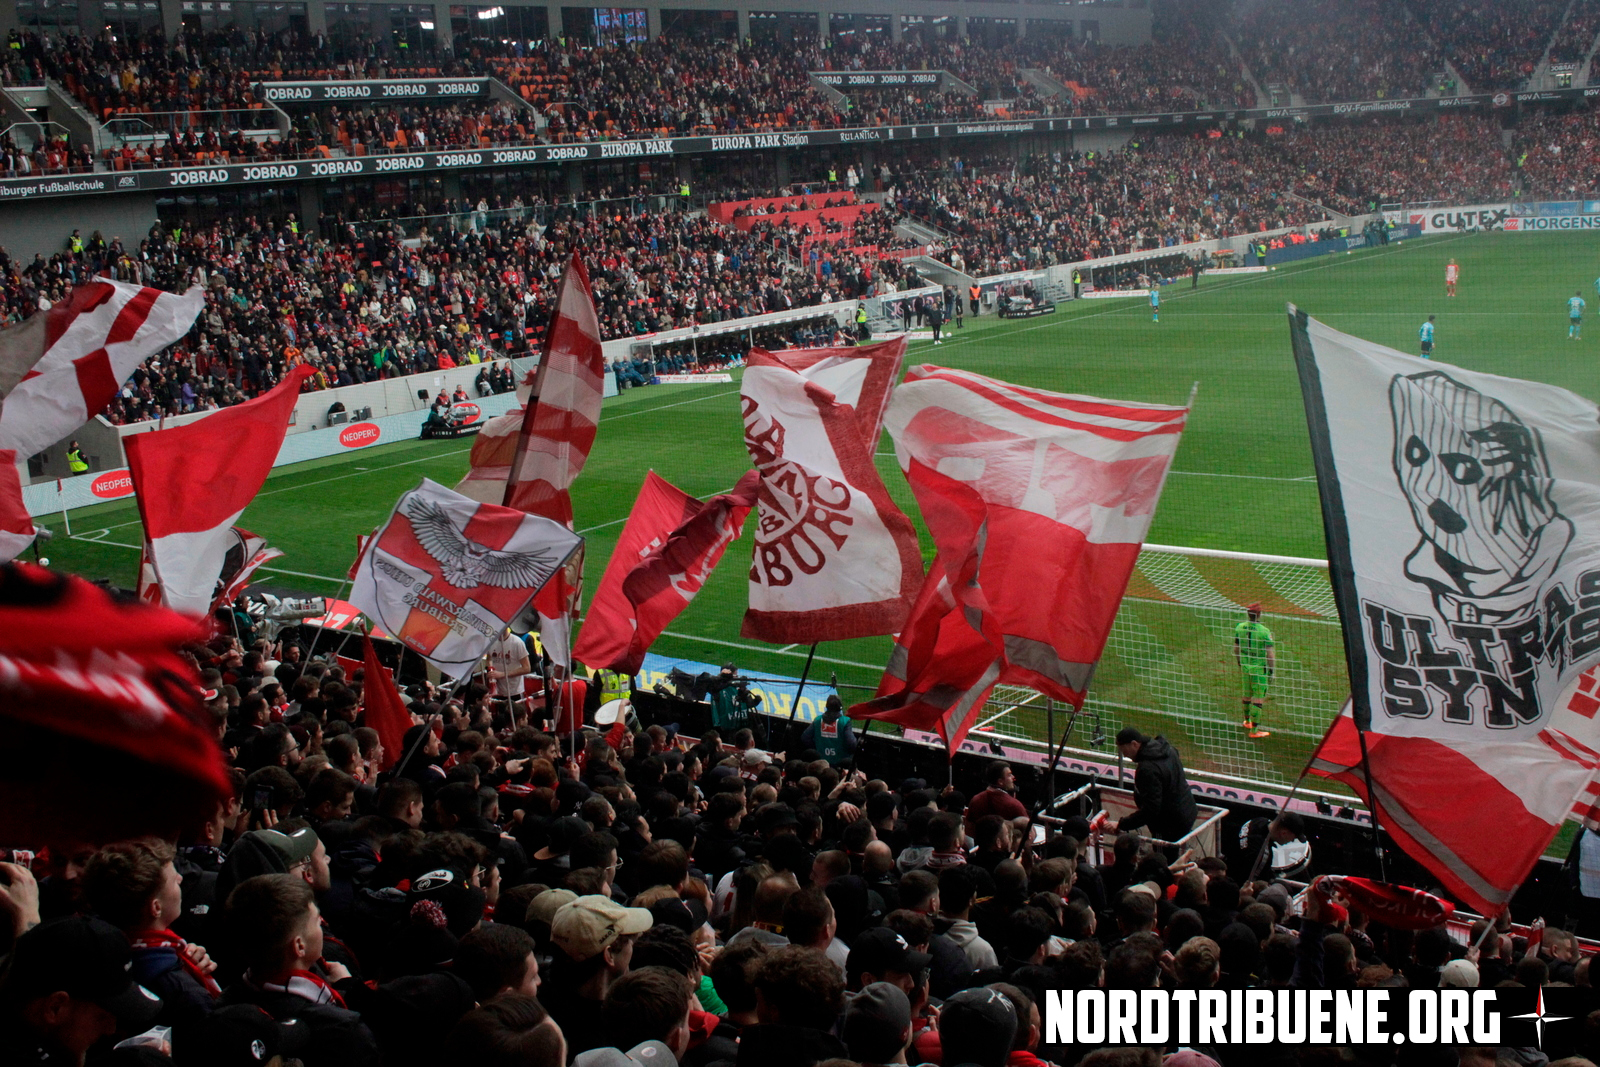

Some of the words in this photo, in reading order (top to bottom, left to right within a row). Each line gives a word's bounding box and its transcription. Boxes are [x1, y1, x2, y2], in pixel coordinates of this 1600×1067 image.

[816, 75, 843, 85] OBRAD
[848, 75, 875, 84] JOBRAD
[880, 75, 907, 84] JOBRAD
[911, 74, 936, 83] JOBRAD
[324, 86, 371, 98] JOBRAD
[382, 85, 427, 96] JOBRAD
[437, 83, 480, 95] JOBRAD
[1333, 101, 1411, 114] BGV-Familienblock
[711, 136, 752, 150] EUROPA
[754, 134, 781, 148] PARK
[782, 133, 809, 147] Stadion
[546, 147, 588, 160] JOBRAD
[600, 141, 642, 157] EUROPA
[645, 140, 674, 154] PARK
[436, 153, 483, 167] JOBRAD
[492, 150, 537, 163] JOBRAD
[311, 160, 363, 175] JOBRAD
[375, 156, 425, 171] JOBRAD
[170, 169, 229, 186] JOBRAD
[243, 165, 298, 181] JOBRAD
[0, 184, 37, 197] iburger
[39, 179, 105, 194] Fußballschule
[1431, 208, 1510, 230] GUTEX
[342, 429, 377, 442] NEOPERL
[96, 477, 133, 492] NEOPER
[824, 747, 837, 756] 05
